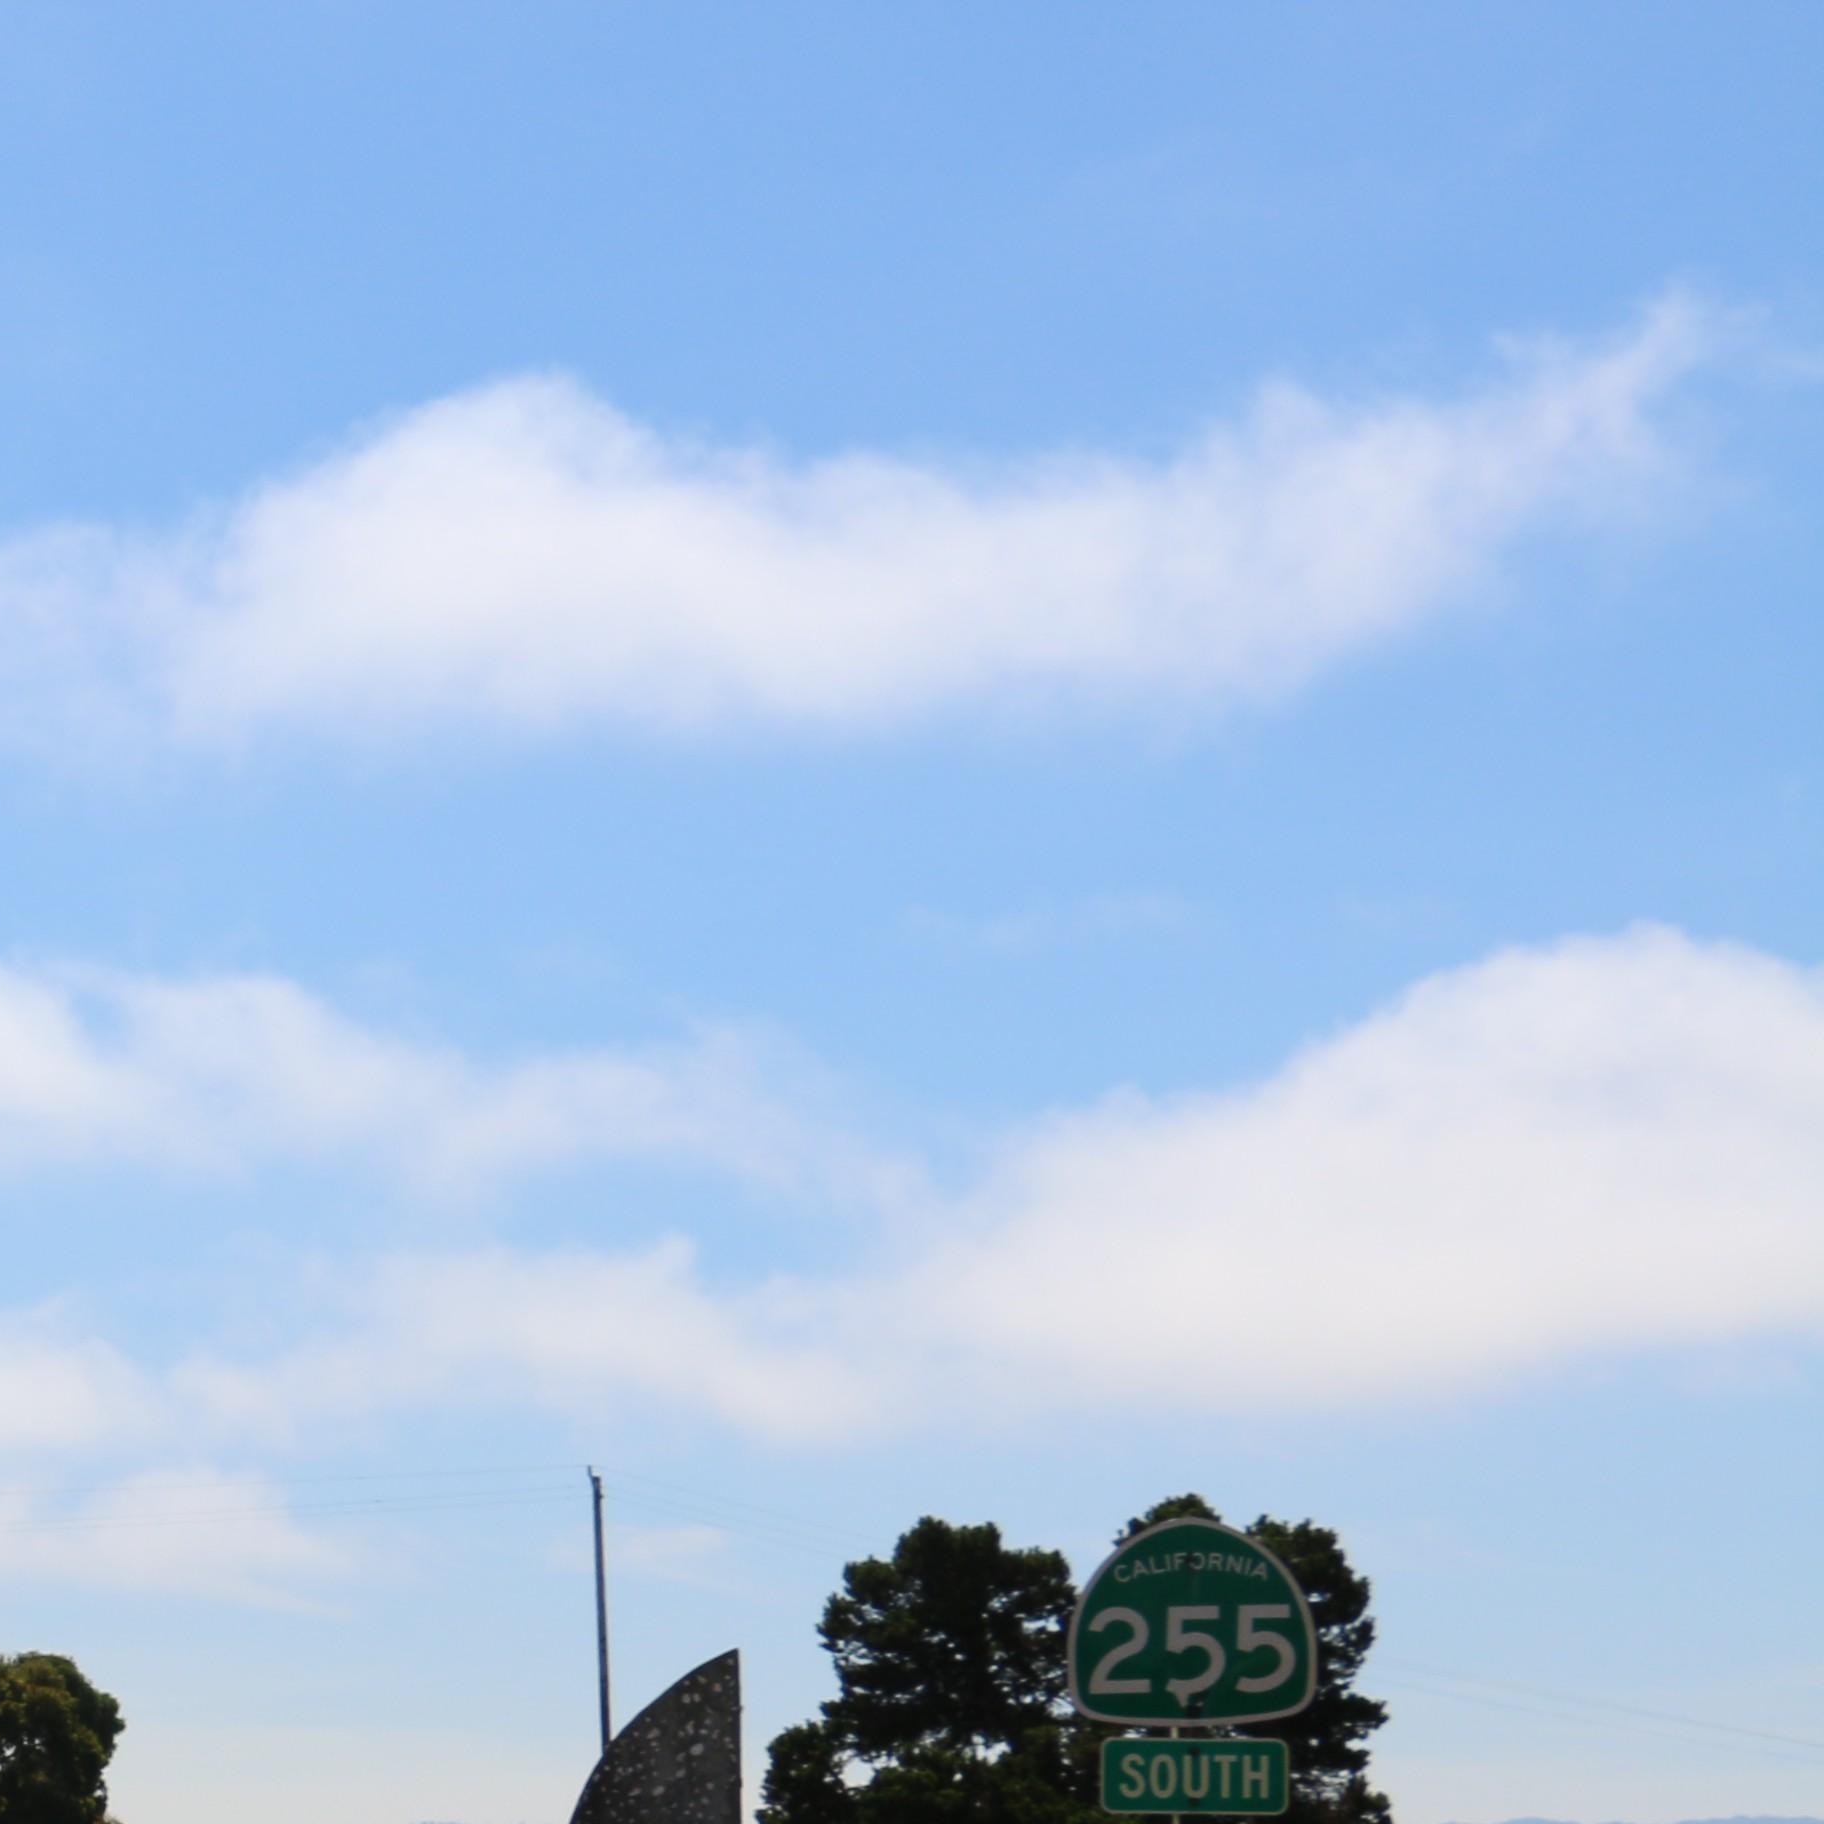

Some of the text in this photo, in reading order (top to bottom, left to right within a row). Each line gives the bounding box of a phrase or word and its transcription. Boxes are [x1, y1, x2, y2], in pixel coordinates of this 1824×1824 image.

[1114, 1552, 1269, 1583] CALIFORNIA
[1088, 1603, 1297, 1698] 255
[1120, 1753, 1269, 1799] SOUTH
